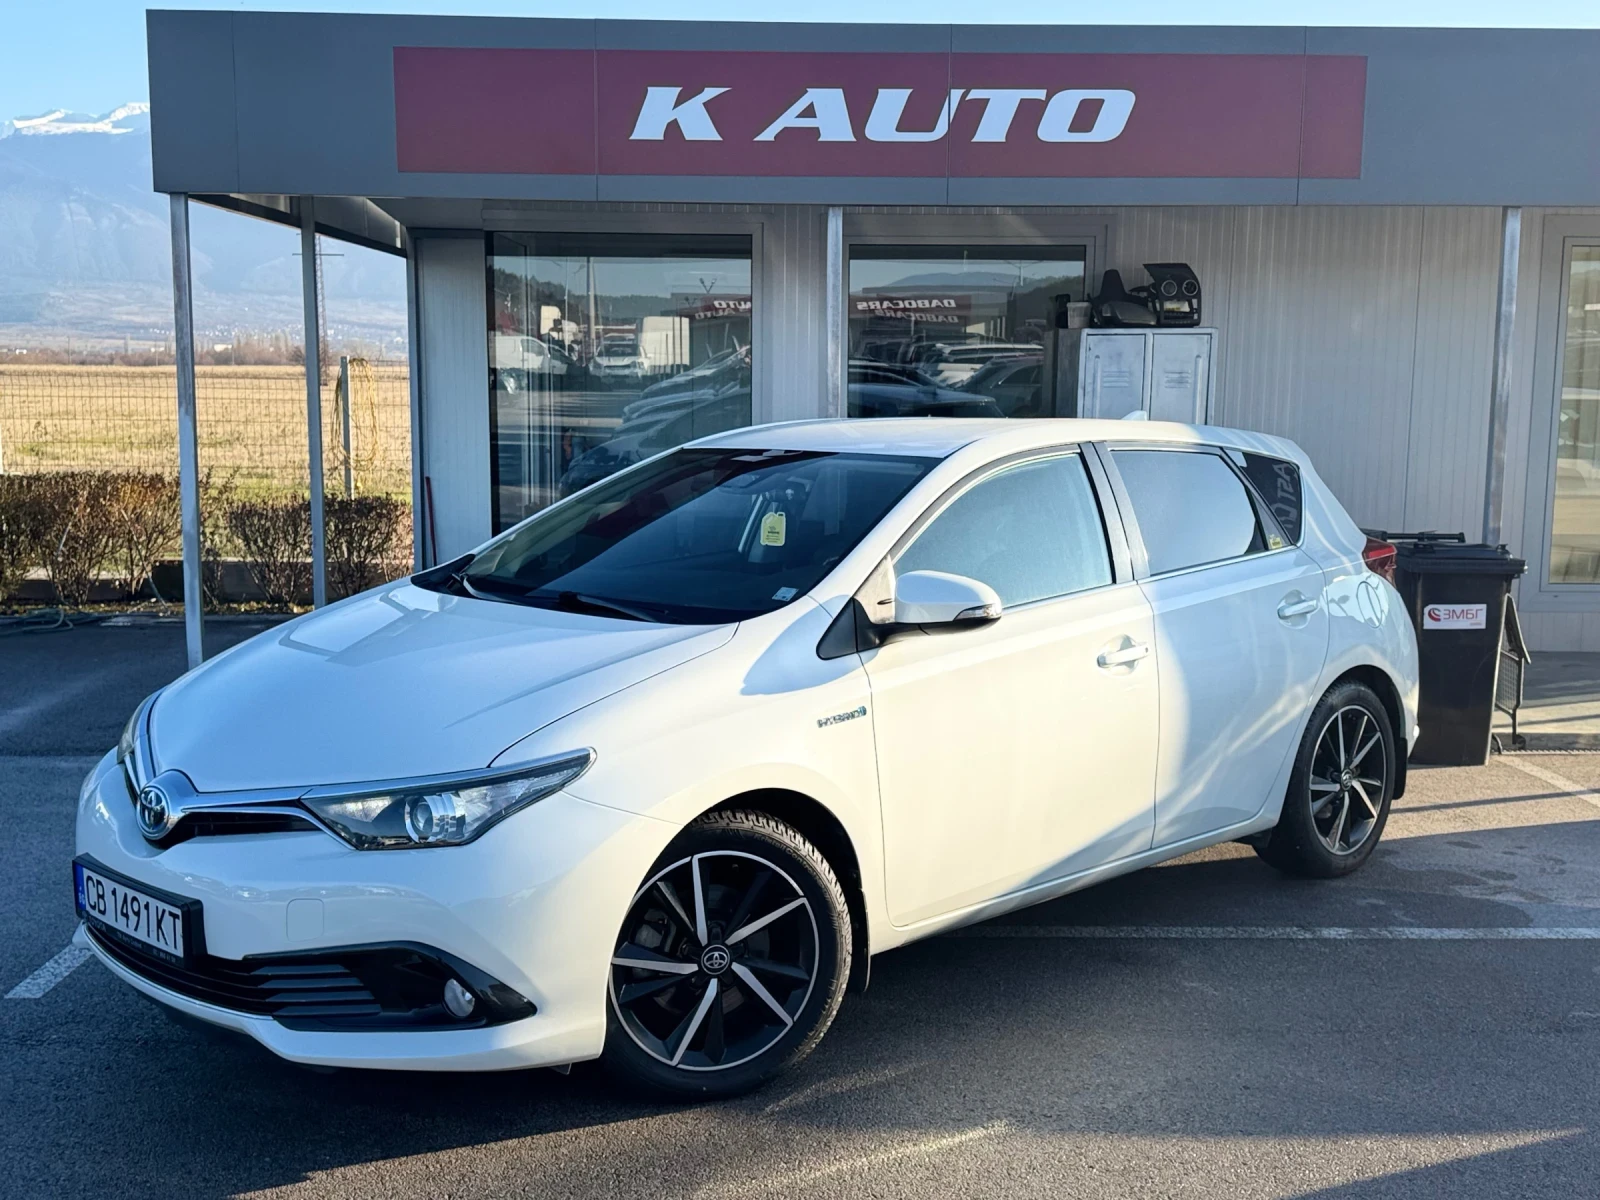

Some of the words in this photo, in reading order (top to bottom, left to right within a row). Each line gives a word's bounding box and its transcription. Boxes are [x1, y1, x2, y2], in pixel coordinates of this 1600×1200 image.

[629, 87, 732, 140] K
[753, 87, 1136, 142] AUTO
[1443, 608, 1484, 620] ЗМБГ
[86, 875, 106, 916] CB
[111, 887, 151, 938] 1491
[156, 905, 180, 950] KT
